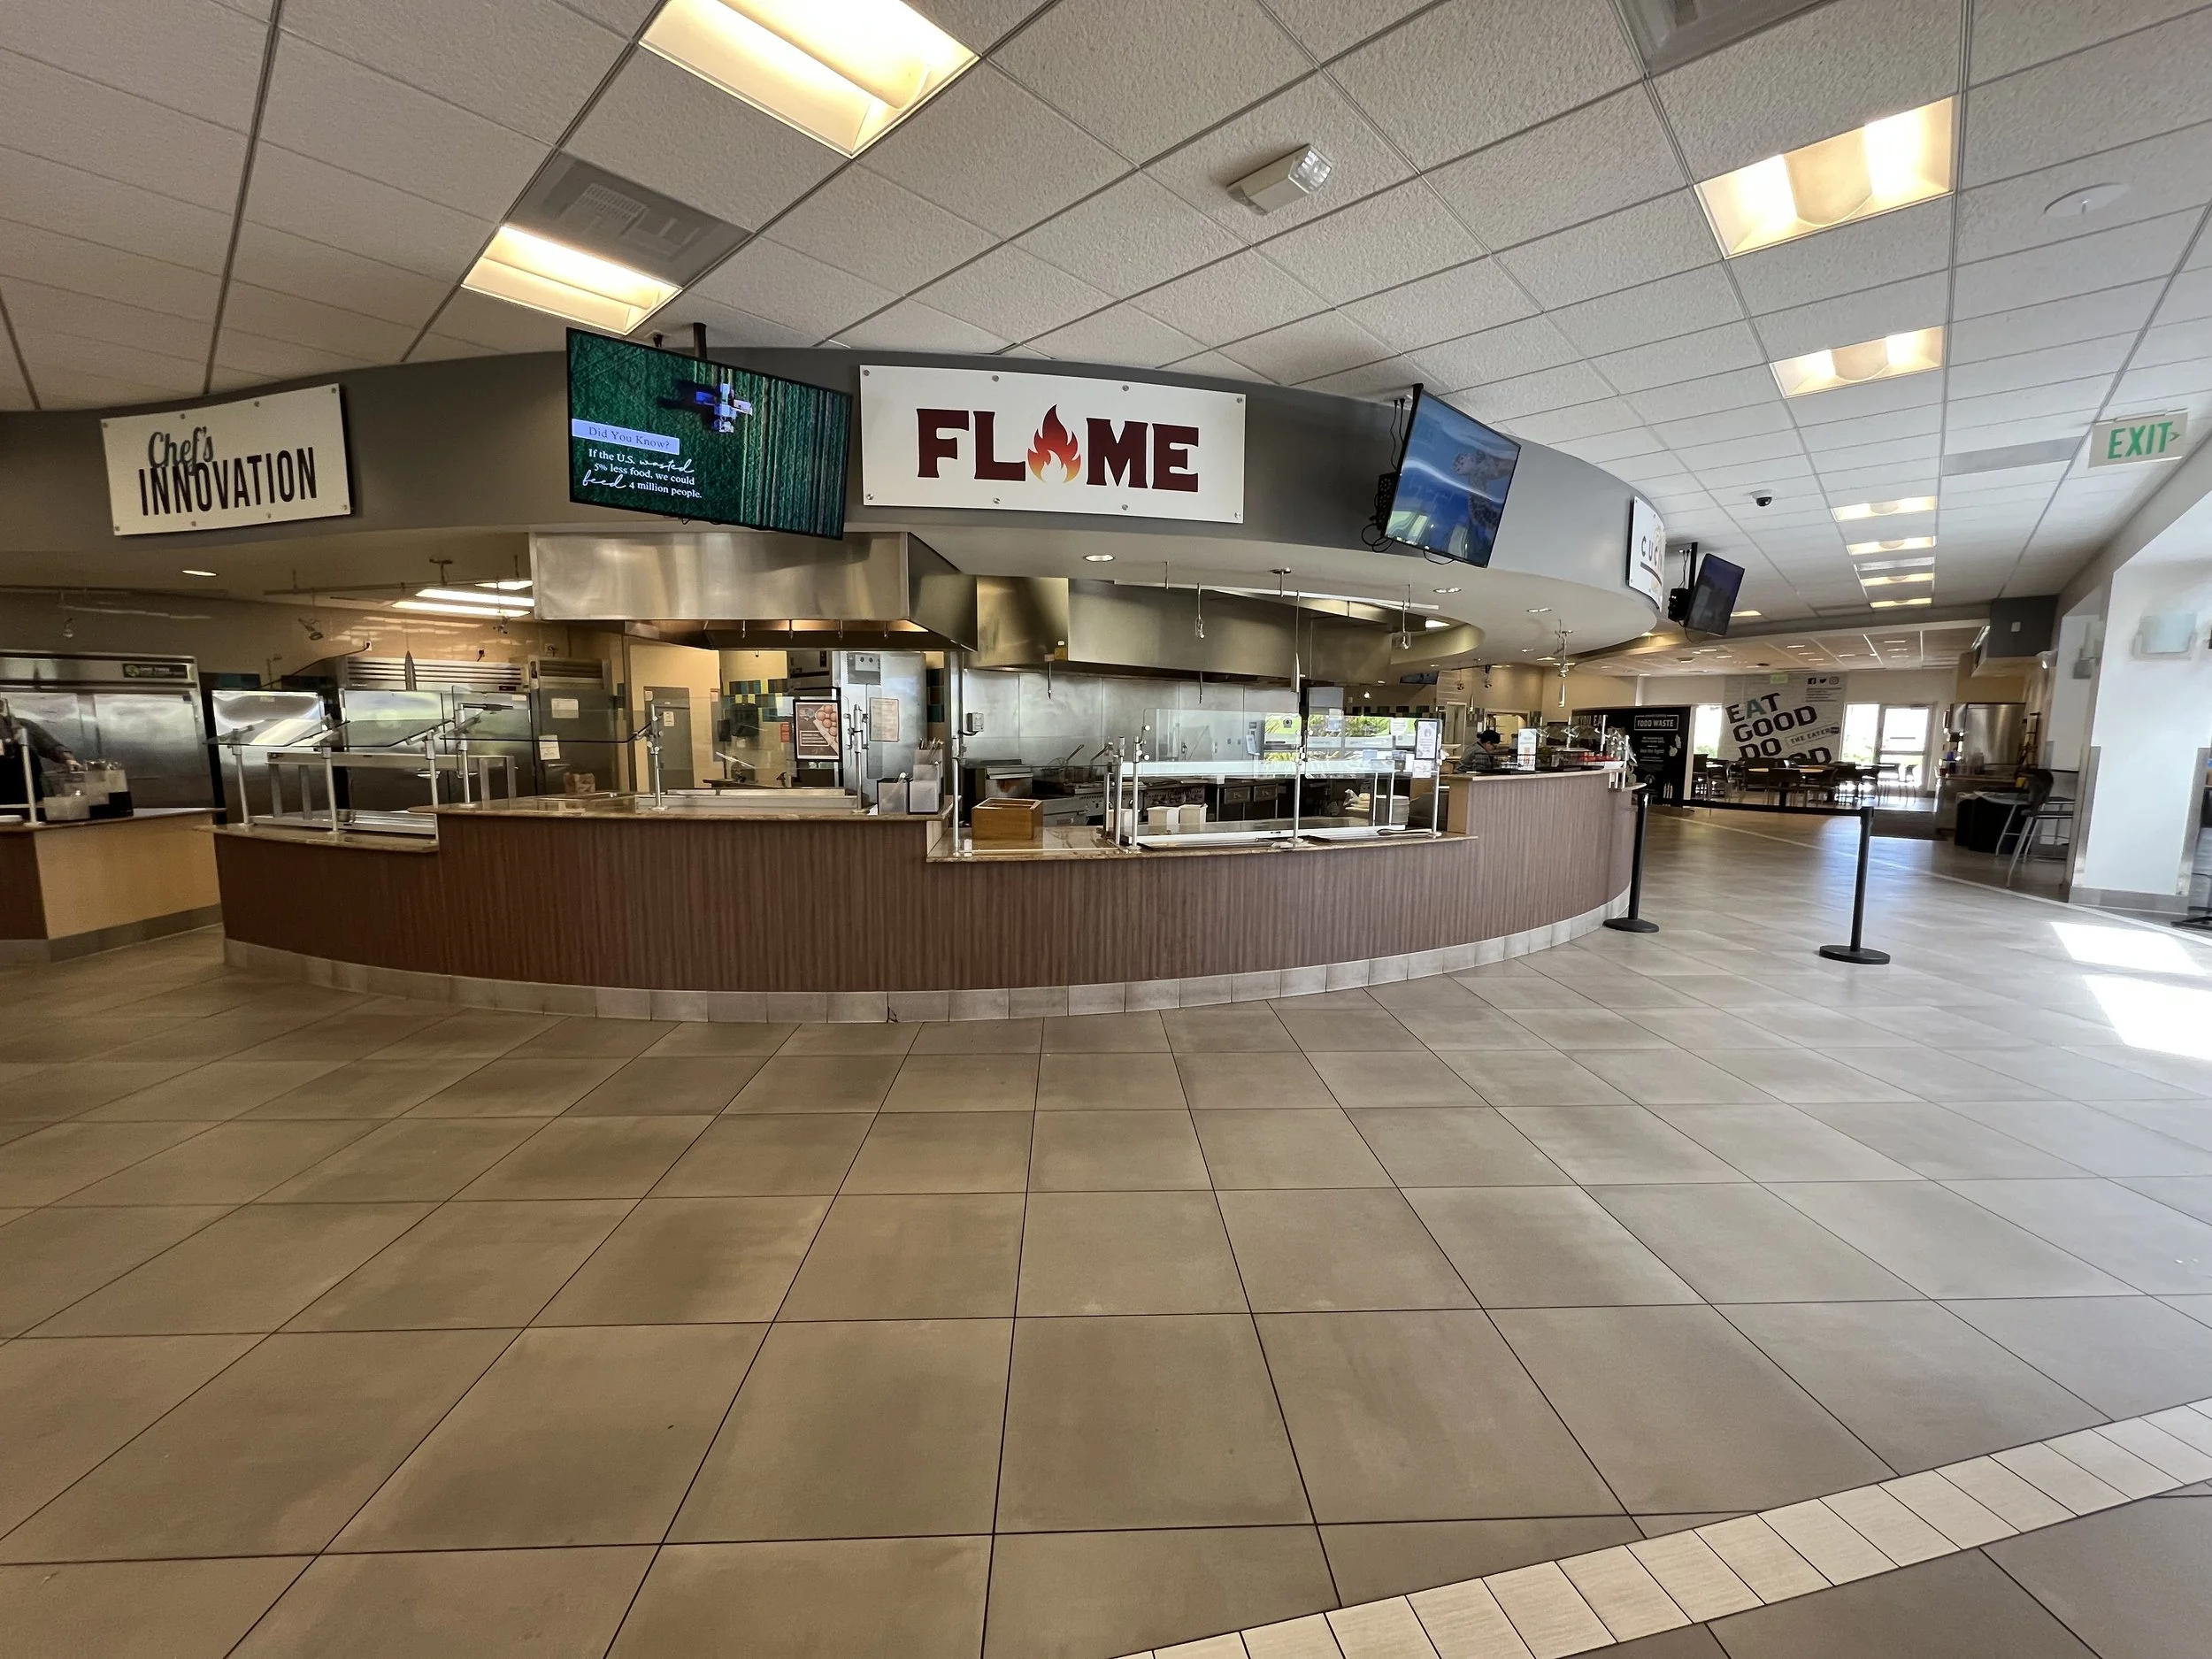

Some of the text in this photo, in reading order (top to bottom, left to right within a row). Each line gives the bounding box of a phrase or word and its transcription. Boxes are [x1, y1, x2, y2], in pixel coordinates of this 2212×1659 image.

[148, 426, 214, 476] Chef's
[588, 426, 670, 449] Did You Know?
[2108, 421, 2174, 460] EXIT
[588, 449, 695, 473] If the U.S. wasted
[594, 462, 695, 486] 5% less food, we could
[139, 447, 317, 516] INNOVATION
[582, 469, 703, 499] feed 4 million people.
[1594, 715, 1609, 726] EA
[1725, 693, 1780, 725] EAT
[1732, 706, 1818, 742] GOOD
[1739, 738, 1782, 759] DO
[1790, 734, 1806, 744] THE
